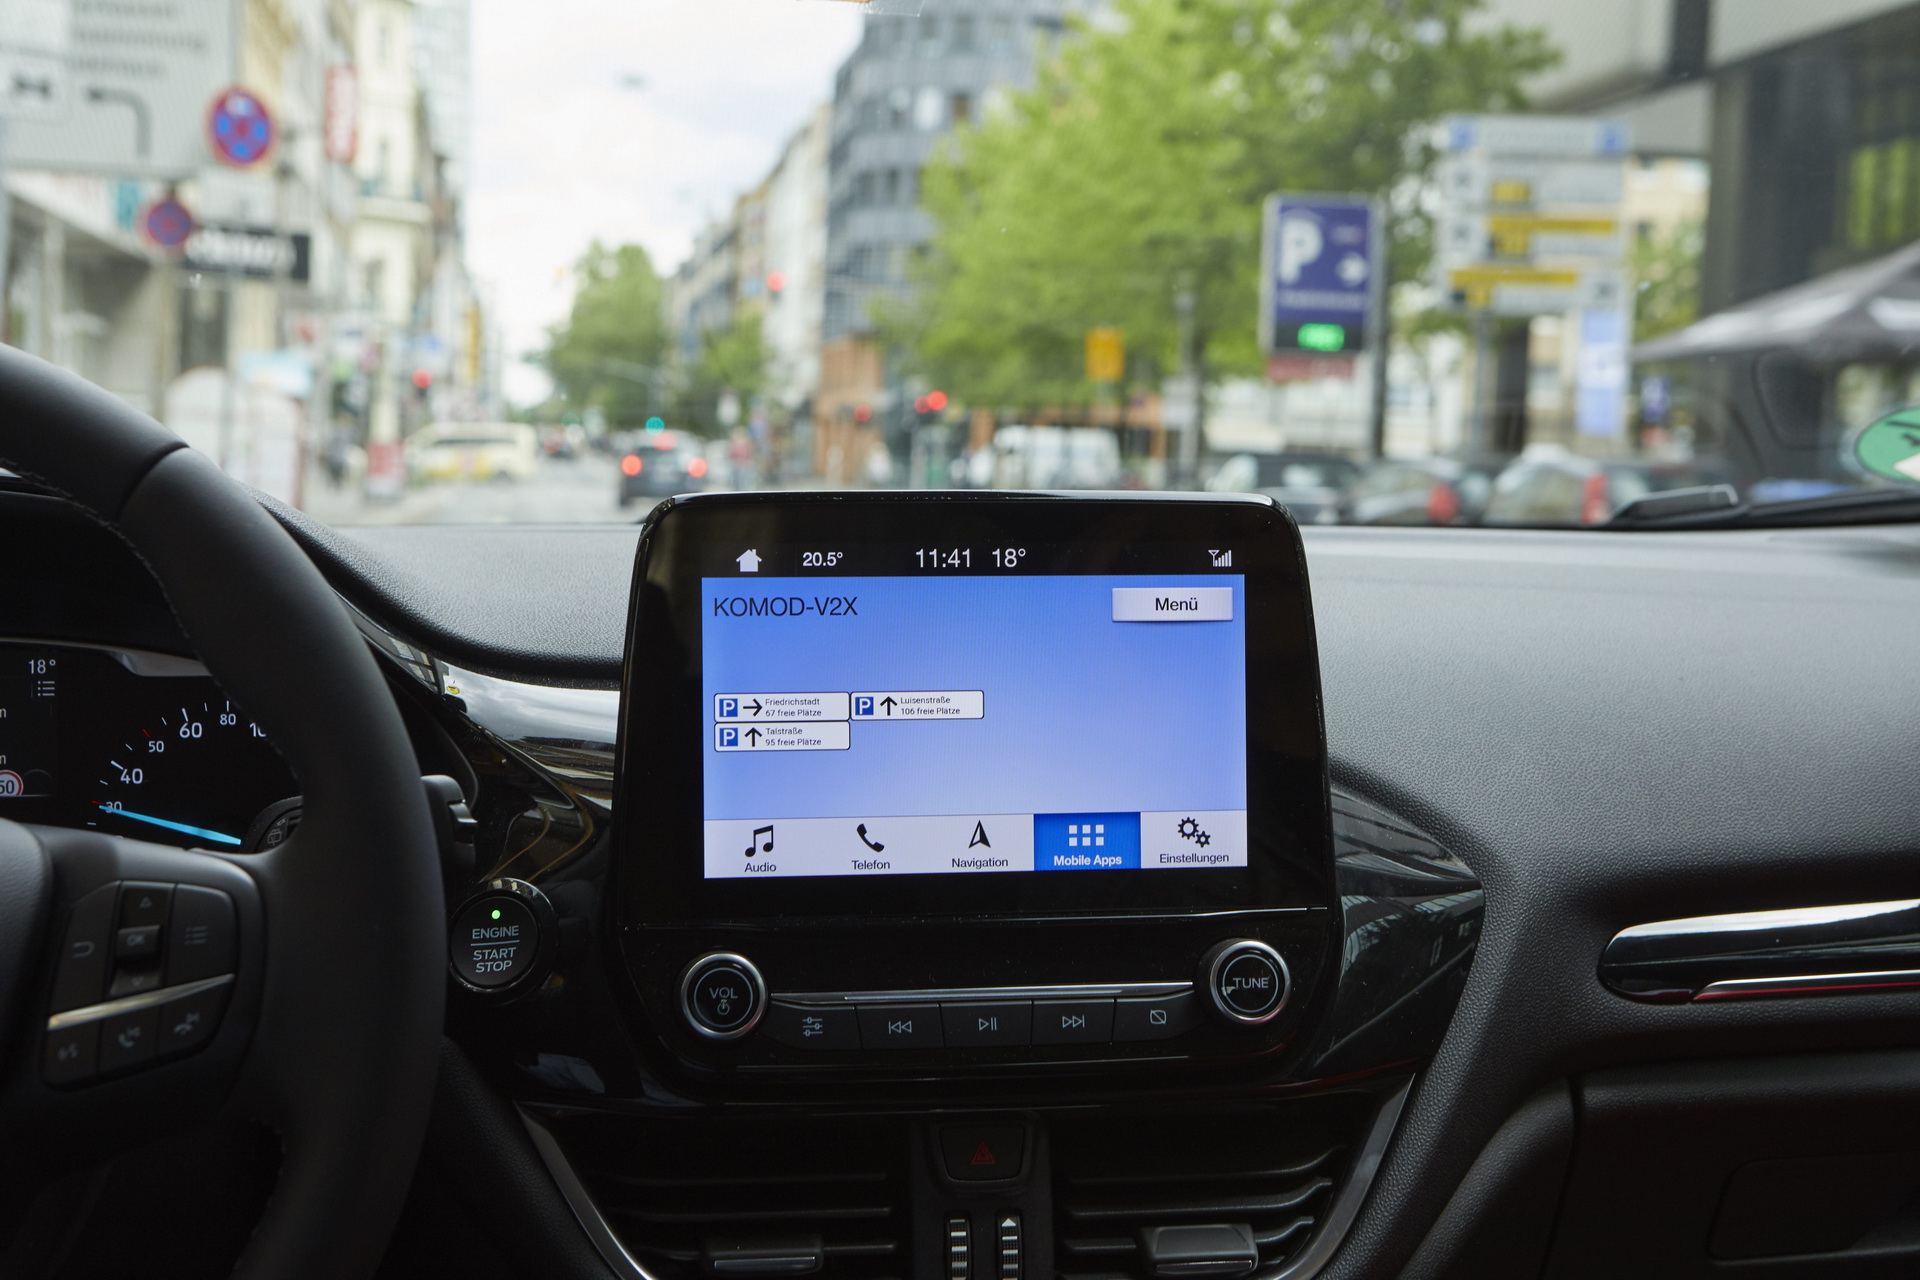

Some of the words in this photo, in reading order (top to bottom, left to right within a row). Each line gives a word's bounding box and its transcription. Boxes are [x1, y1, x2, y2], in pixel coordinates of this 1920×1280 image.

[802, 552, 843, 567] 20.5°
[915, 548, 971, 568] 11:41
[992, 548, 1026, 568] 18°
[713, 596, 858, 617] KOMOD-V2X
[1155, 597, 1198, 612] Menü
[765, 698, 820, 706] Friedrichstadt
[900, 696, 951, 704] Luisenstraße
[777, 709, 796, 717] freie
[797, 709, 822, 717] Plätze
[916, 707, 935, 715] freie
[936, 706, 961, 715] Plätze
[219, 713, 237, 726] 80
[179, 722, 203, 739] 60
[148, 740, 165, 753] 50
[777, 738, 796, 746] freie
[797, 738, 822, 746] Plätze
[120, 768, 143, 784] 40
[851, 859, 891, 870] Telefon
[951, 857, 1009, 870] Navigation
[1053, 855, 1091, 867] Mobile
[1093, 854, 1122, 869] Apps
[1159, 853, 1230, 866] Einstellungen
[744, 862, 777, 873] Audio
[472, 925, 520, 940] ENGINE
[473, 947, 516, 961] START
[475, 960, 512, 973] STOP
[1232, 977, 1269, 989] TUNE
[709, 987, 738, 999] VOL
